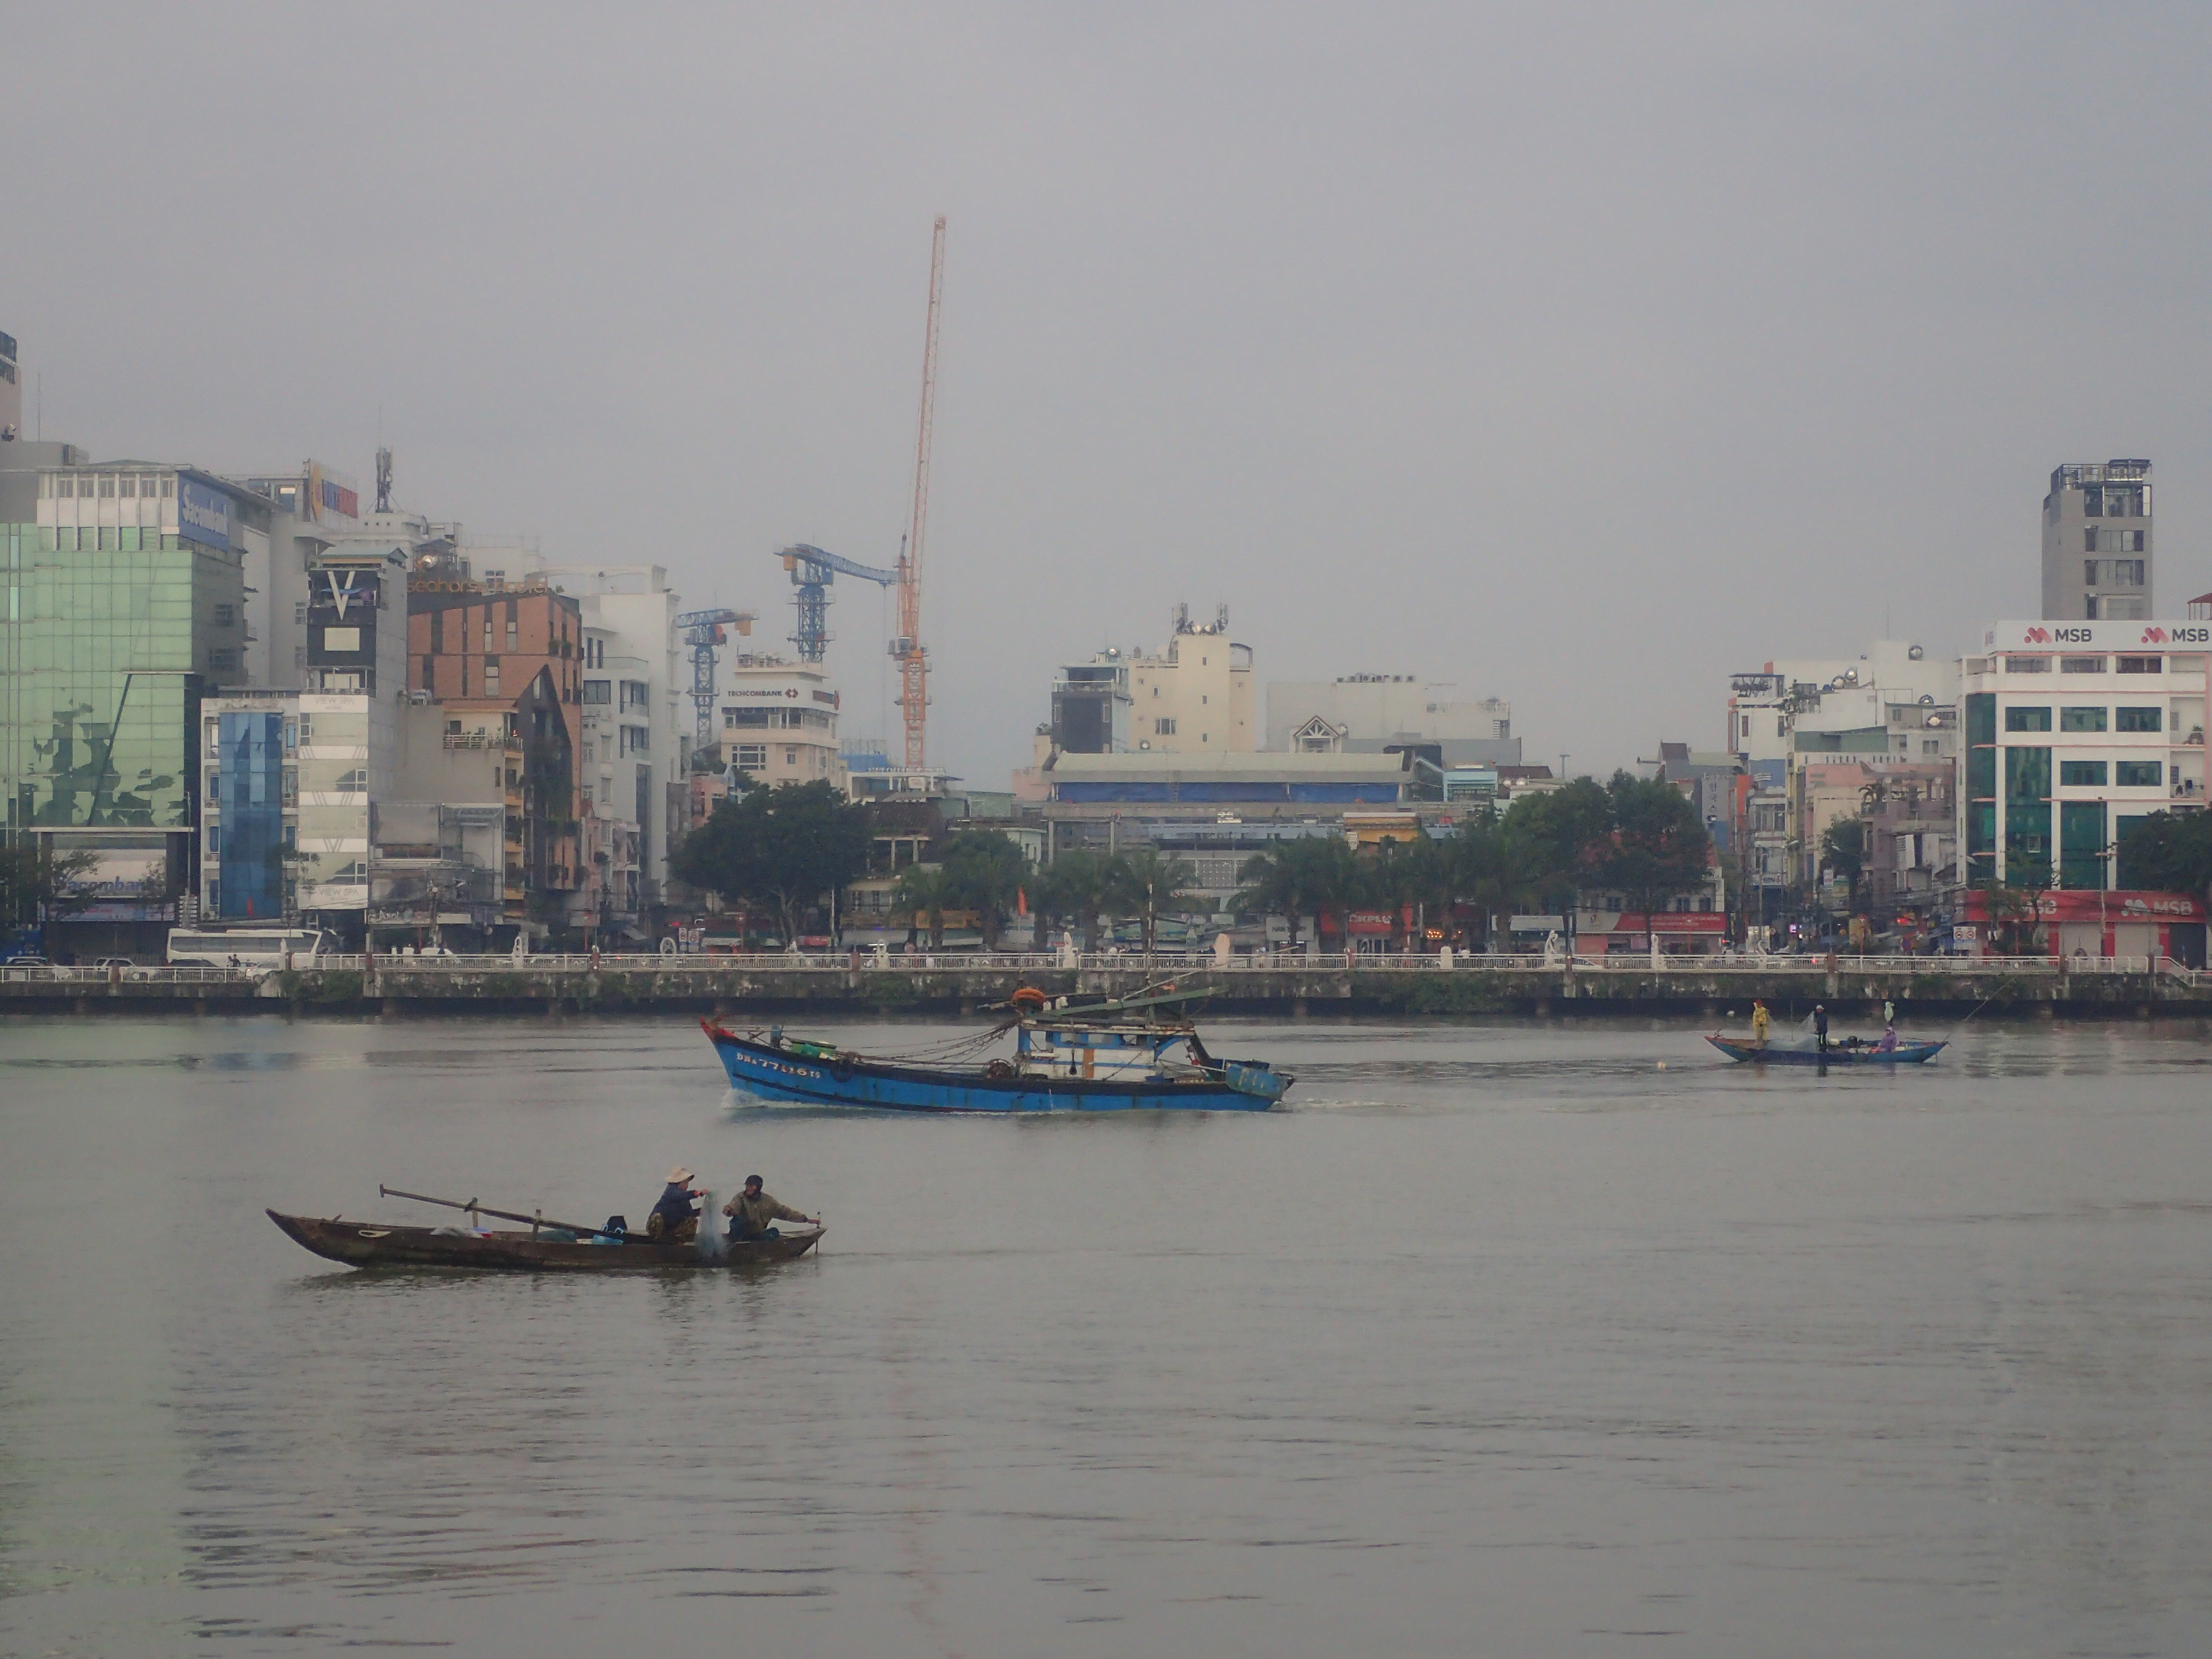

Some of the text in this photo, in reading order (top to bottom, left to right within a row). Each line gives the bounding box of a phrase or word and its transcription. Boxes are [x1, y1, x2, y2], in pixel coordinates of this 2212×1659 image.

[182, 484, 228, 536] Sacombank
[2055, 628, 2092, 643] MSB
[2172, 628, 2209, 642] MSB
[2154, 901, 2193, 916] MSB
